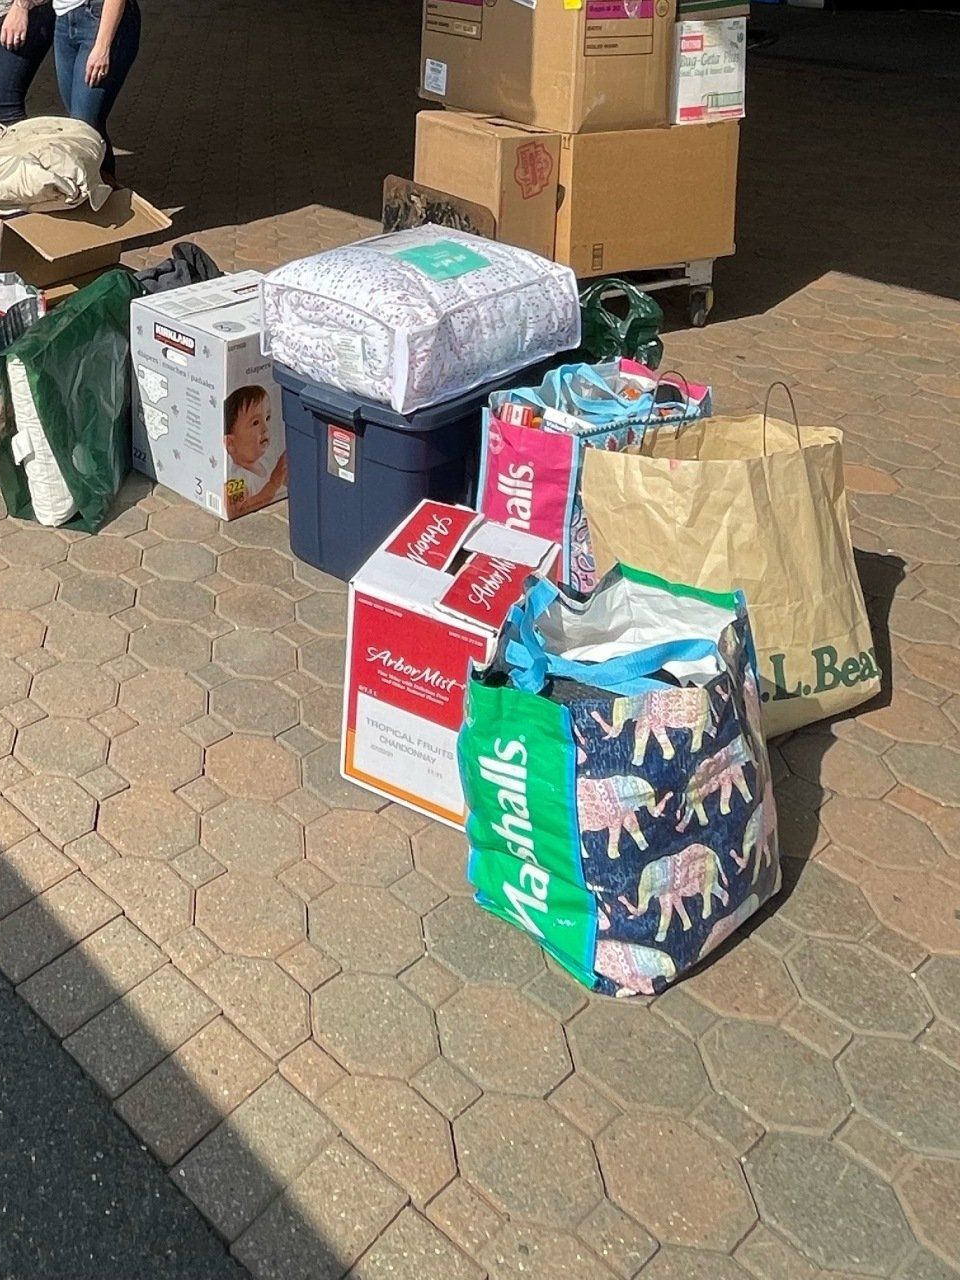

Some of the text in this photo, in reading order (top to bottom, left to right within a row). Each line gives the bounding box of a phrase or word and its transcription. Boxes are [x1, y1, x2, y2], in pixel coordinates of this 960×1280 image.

[155, 324, 195, 349] KIRKLAND
[245, 362, 272, 375] diapers
[194, 476, 203, 495] 3
[226, 479, 245, 495] 222
[366, 716, 415, 745] TROPICAL
[416, 734, 454, 761] FRUITS
[379, 734, 436, 764] CHARDONNAY
[478, 734, 551, 939] Mashalls
